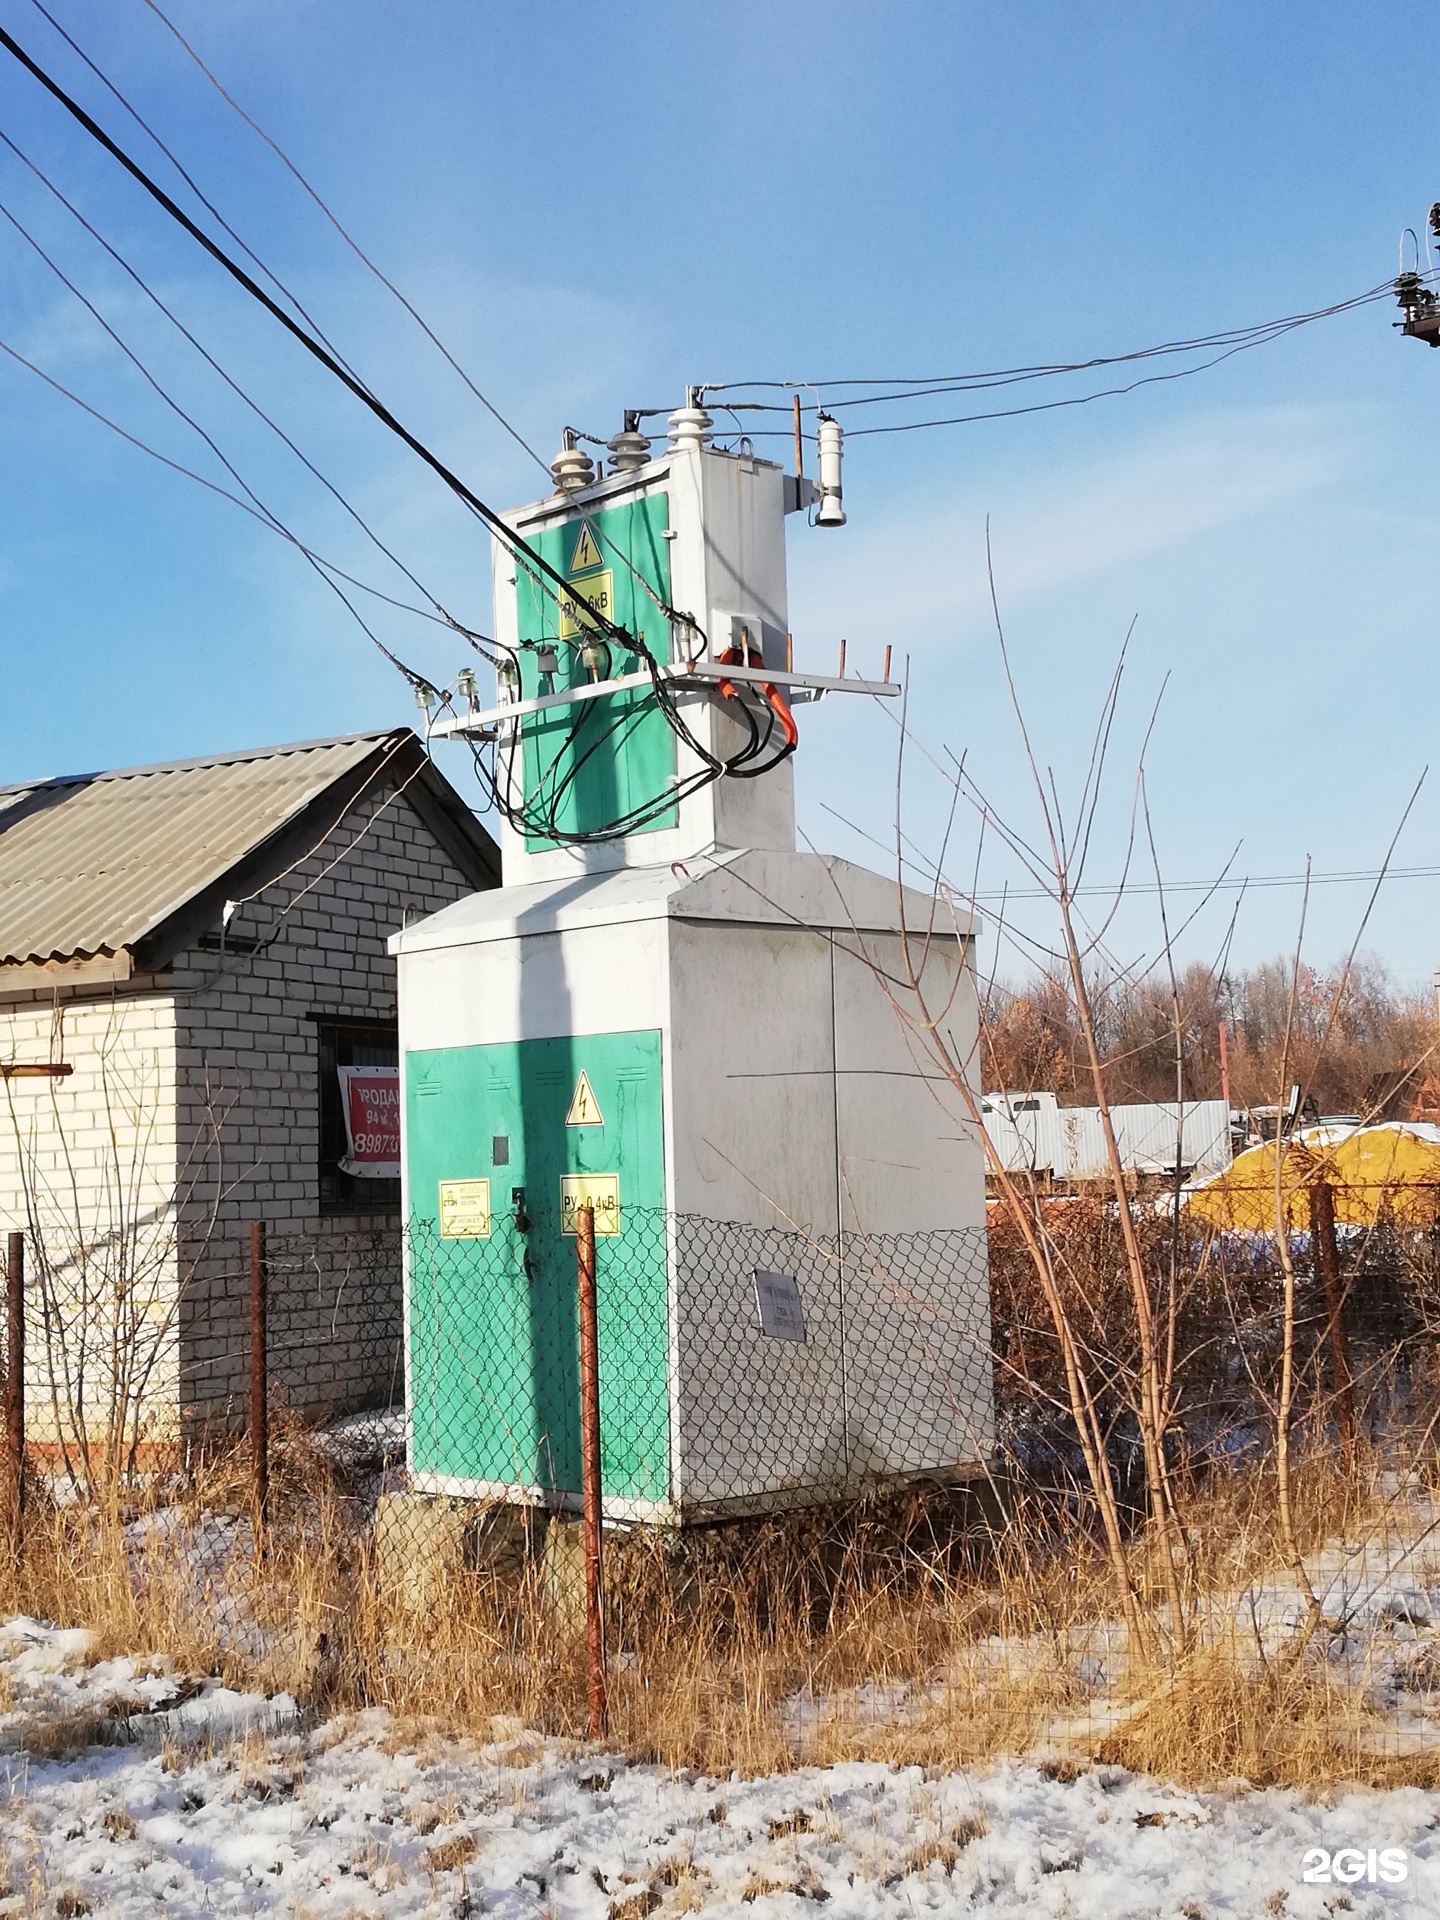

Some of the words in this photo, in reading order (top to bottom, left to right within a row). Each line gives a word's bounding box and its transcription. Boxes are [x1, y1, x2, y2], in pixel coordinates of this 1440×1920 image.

[366, 1110, 379, 1125] 94
[564, 1195, 578, 1211] РУ
[586, 1195, 615, 1211] 04кВ
